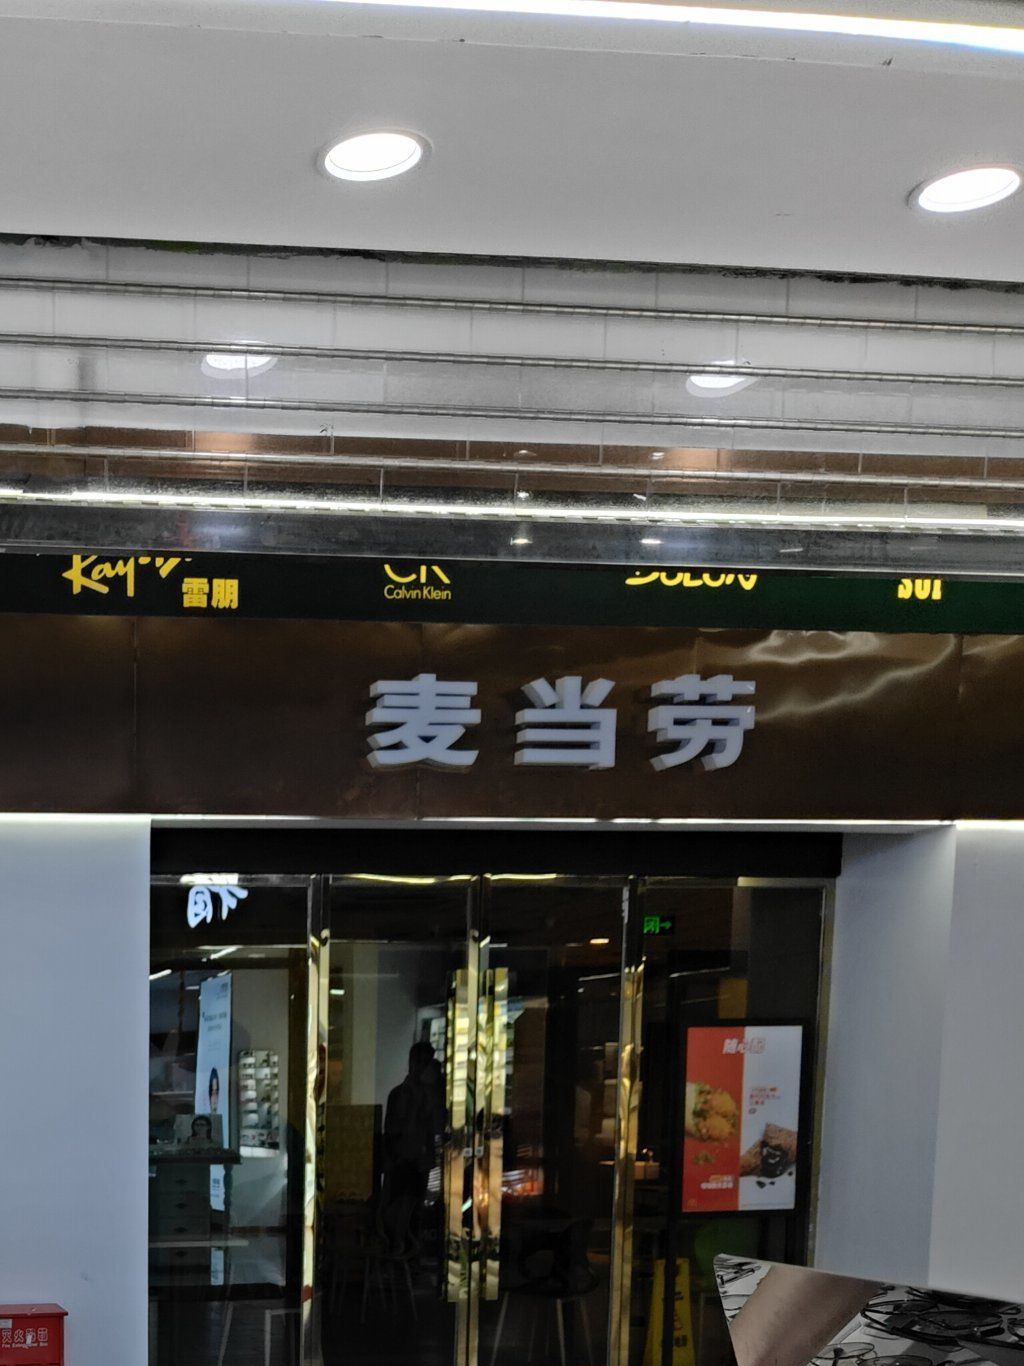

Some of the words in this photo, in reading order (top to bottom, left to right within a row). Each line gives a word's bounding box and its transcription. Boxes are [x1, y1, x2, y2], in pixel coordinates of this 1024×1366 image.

[182, 577, 239, 609] 雷朋
[384, 584, 421, 600] Calvin
[422, 586, 452, 600] Klein
[365, 673, 756, 771] 麦当劳
